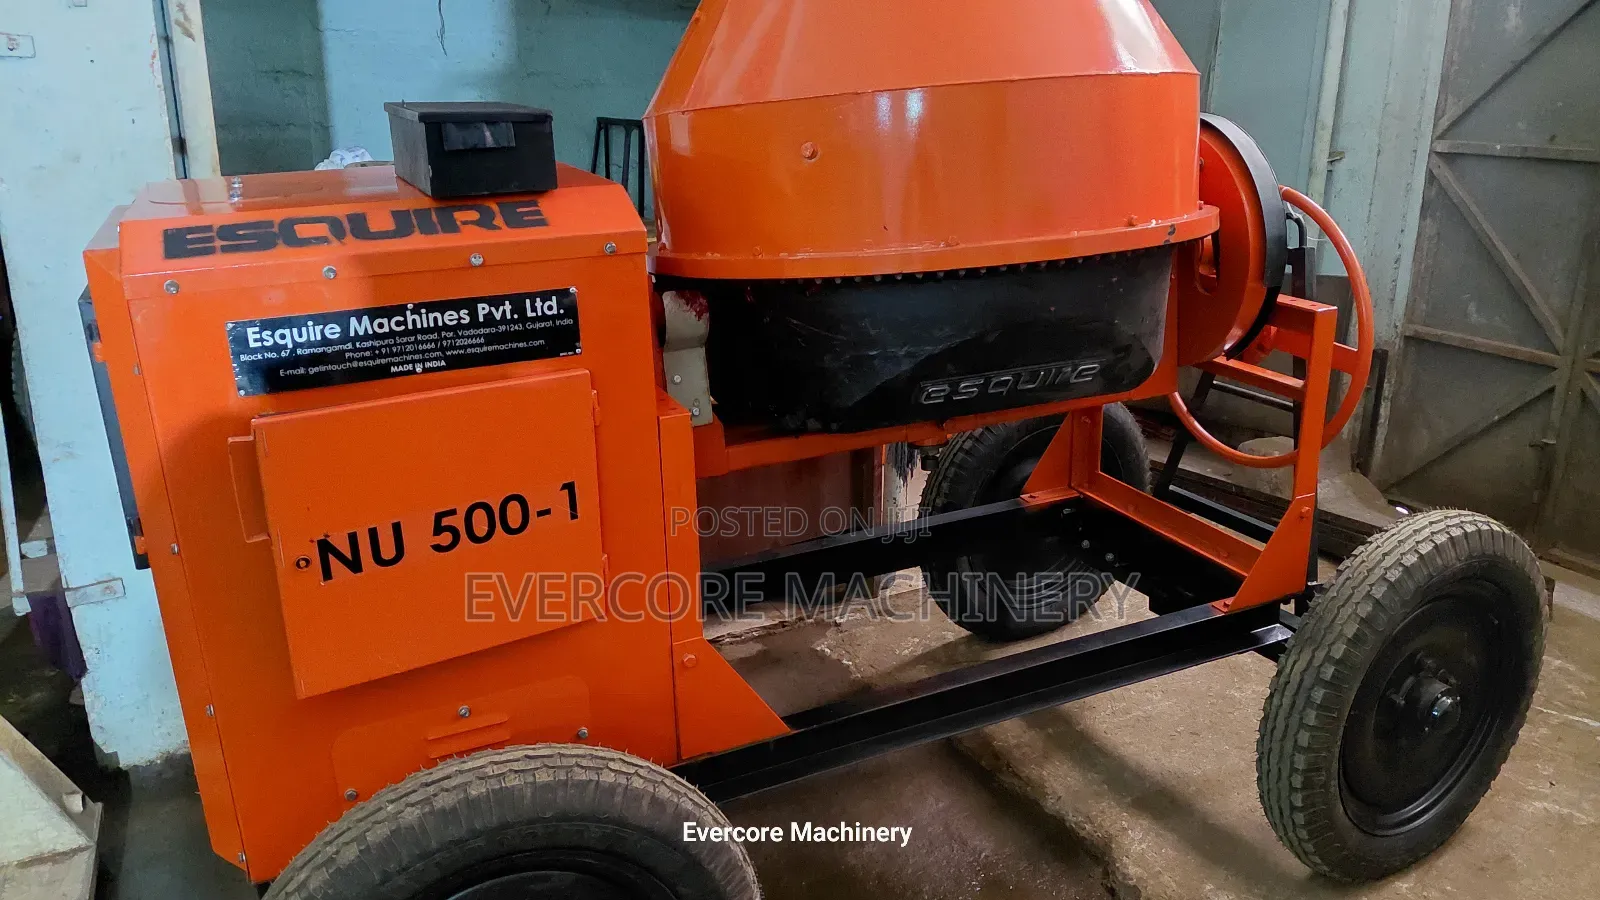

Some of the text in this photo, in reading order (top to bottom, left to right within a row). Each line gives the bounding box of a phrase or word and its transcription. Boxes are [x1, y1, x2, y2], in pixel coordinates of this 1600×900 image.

[162, 200, 549, 260] ESQUIRE
[240, 353, 262, 361] Block
[264, 351, 279, 359] No.
[556, 318, 573, 326] India
[246, 296, 564, 348] Esquire Machines Pvt. Ltd.
[345, 350, 373, 359] Phone:
[381, 347, 389, 355] 91
[392, 341, 435, 353] 9712016666
[442, 336, 485, 347] 9712026666
[391, 365, 413, 373] MADE
[425, 360, 446, 368] INDIA
[446, 340, 545, 355] www.esquiremachines.com
[921, 364, 1100, 404] esquire
[317, 481, 579, 582] NU 500-1
